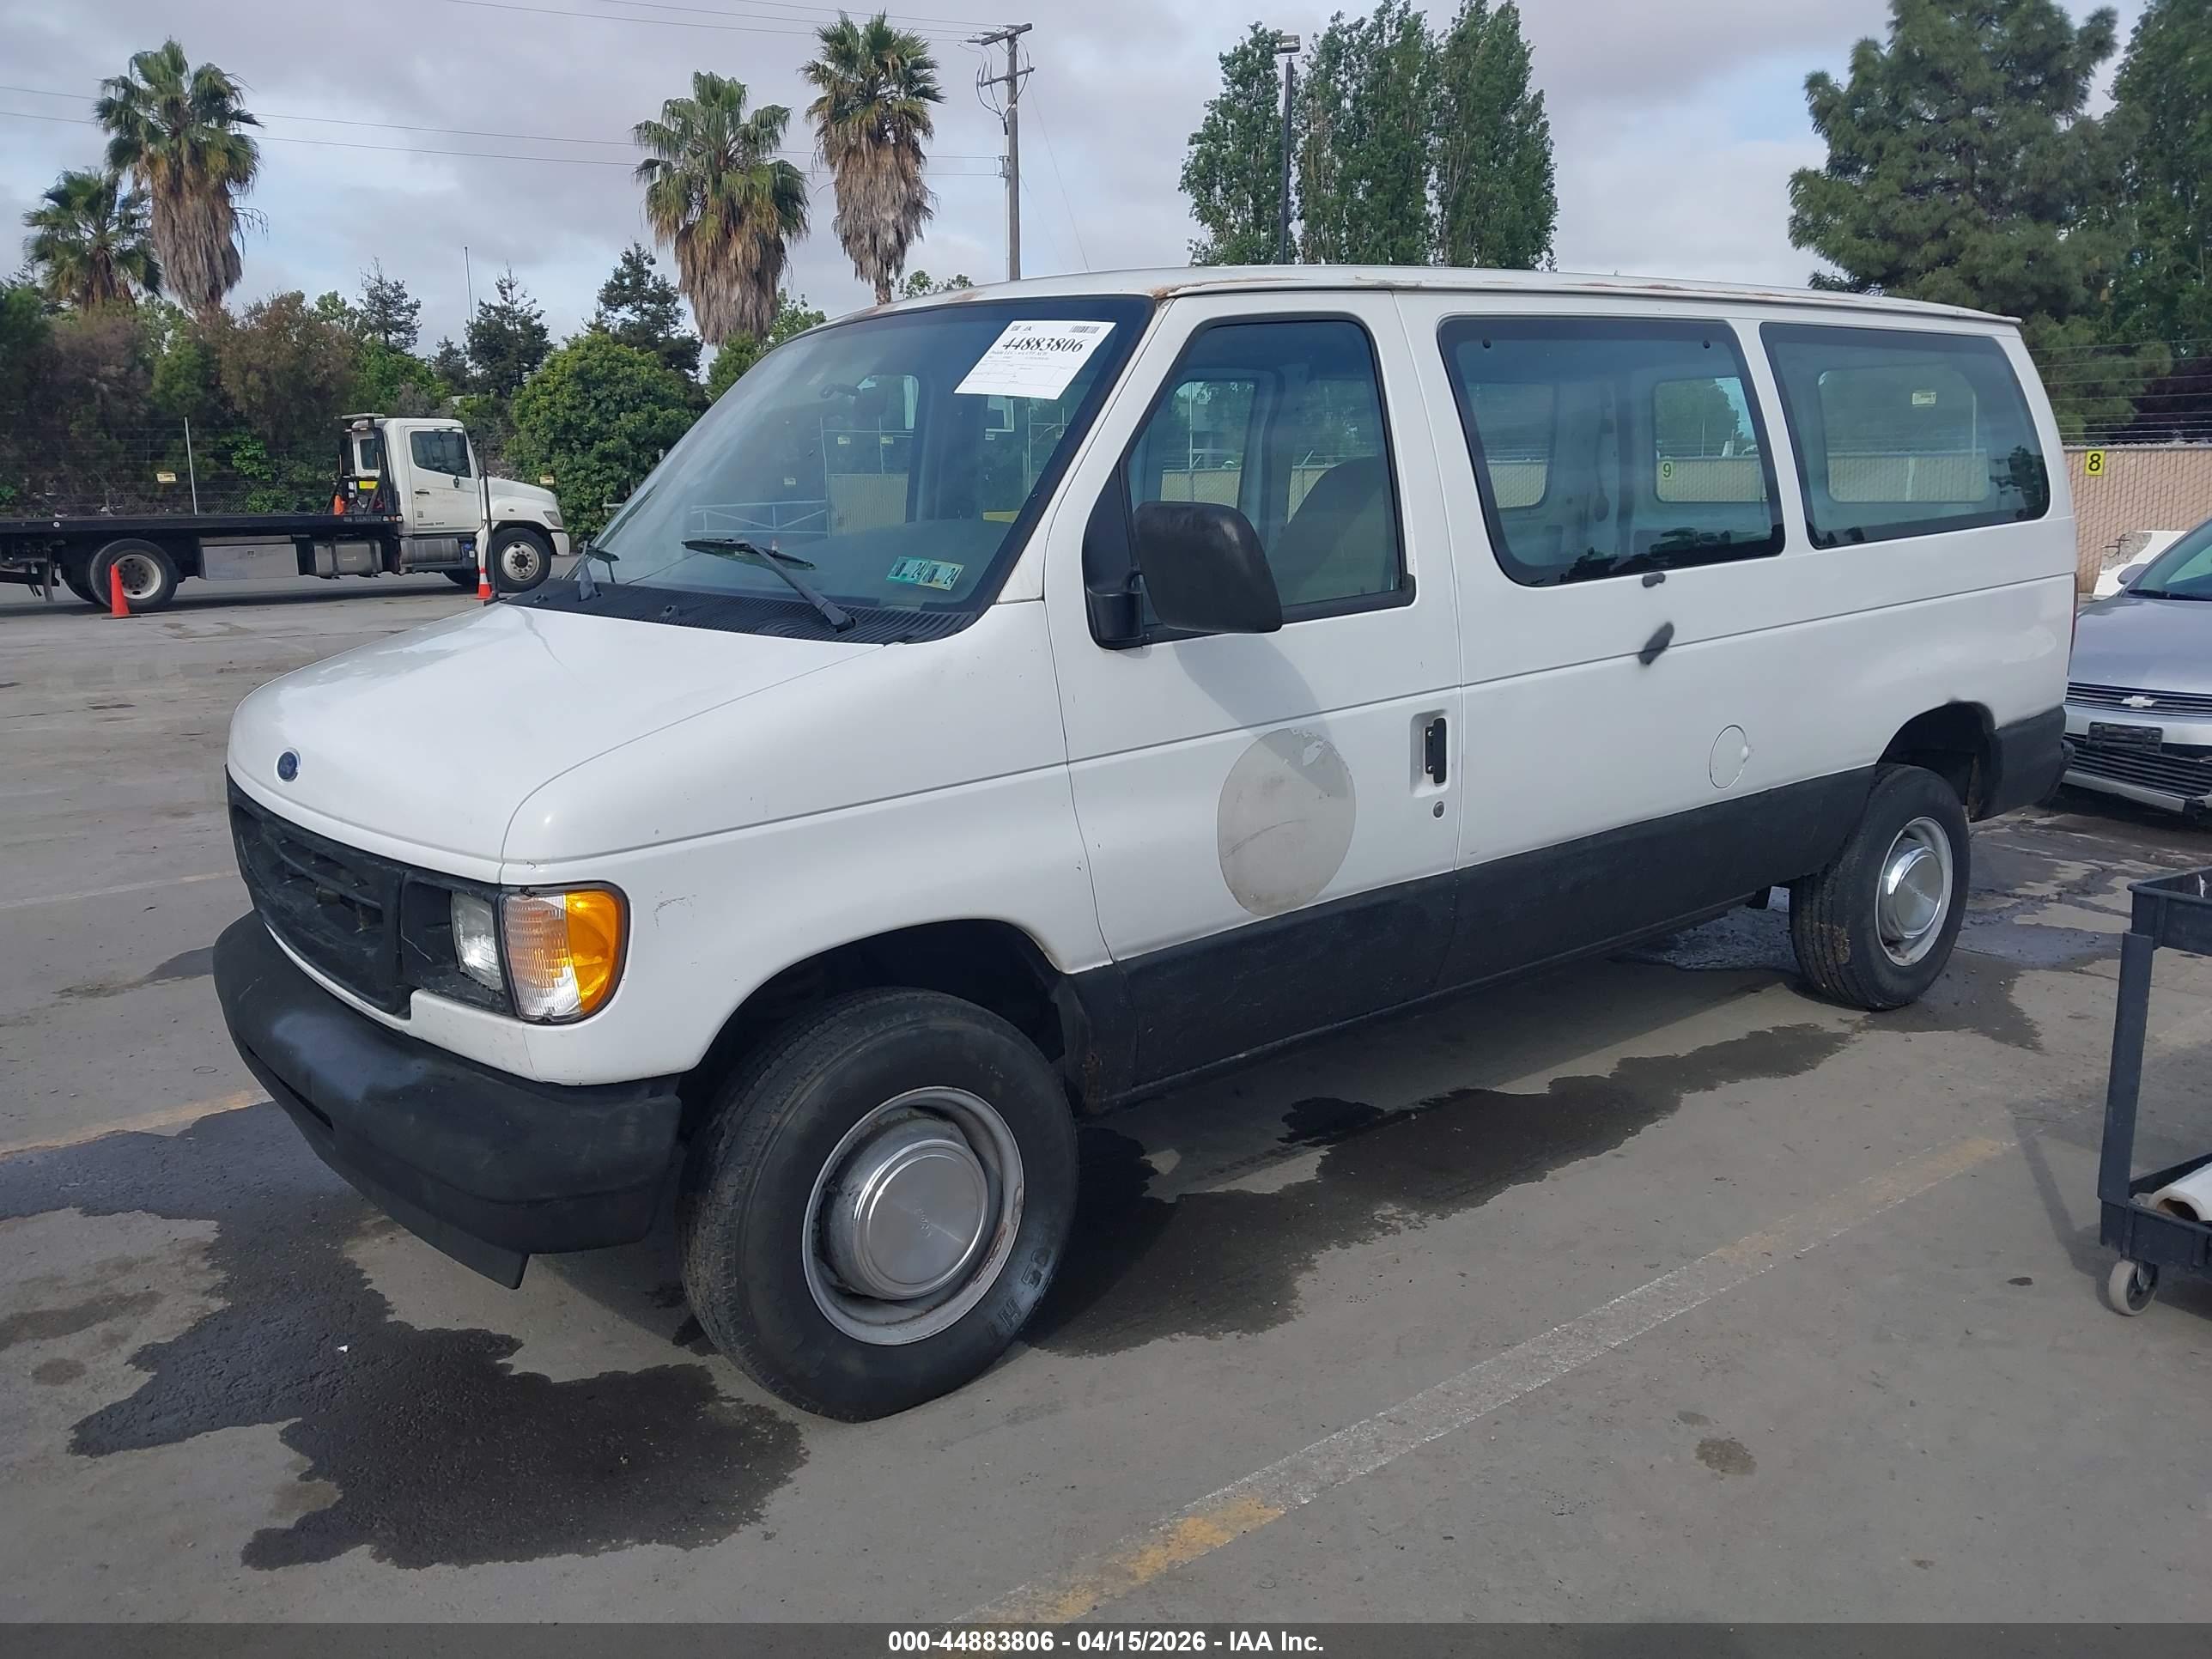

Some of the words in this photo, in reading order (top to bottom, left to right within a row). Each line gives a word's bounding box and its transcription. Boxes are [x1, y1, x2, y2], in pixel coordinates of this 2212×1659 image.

[1003, 337, 1086, 353] 44883806
[1662, 462, 1672, 478] 9
[2088, 453, 2101, 471] 8
[944, 568, 961, 585] 24
